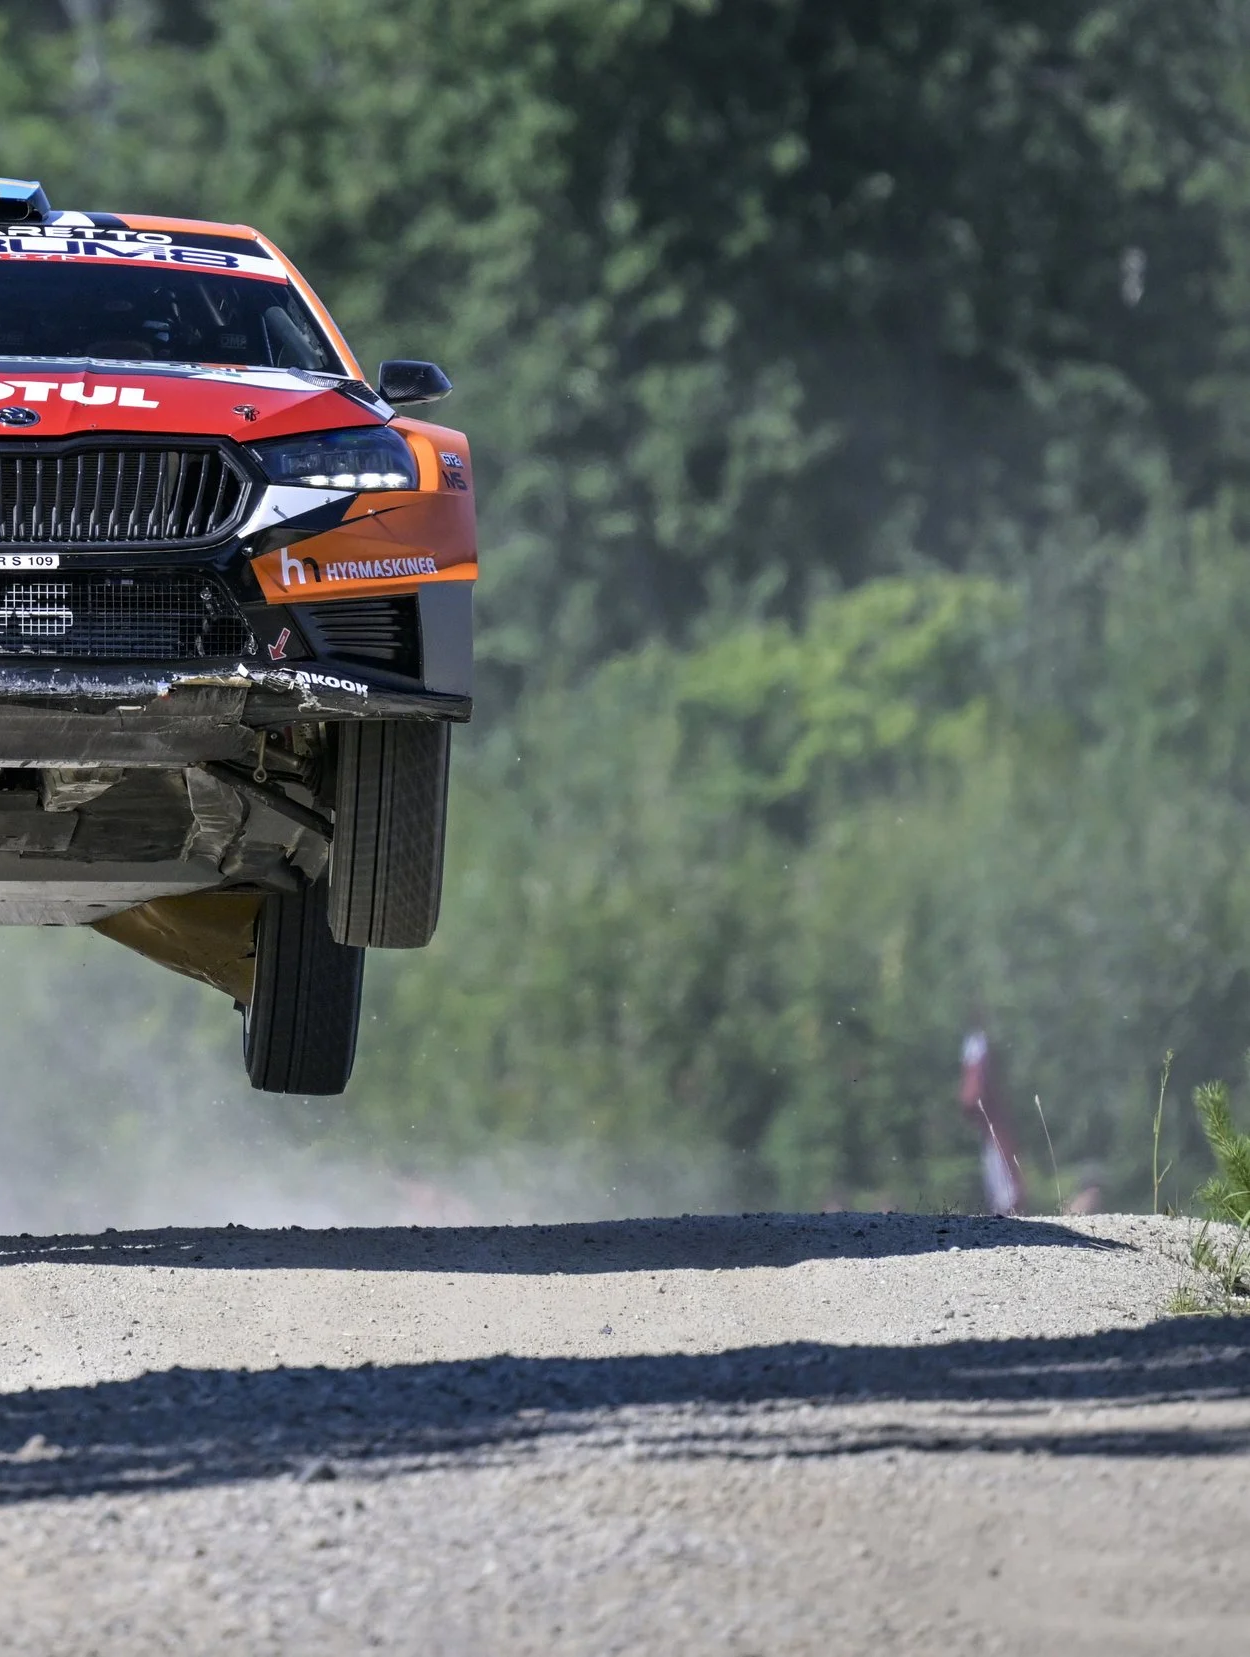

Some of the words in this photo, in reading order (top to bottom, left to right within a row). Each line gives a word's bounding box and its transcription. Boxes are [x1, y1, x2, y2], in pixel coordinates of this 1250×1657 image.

[12, 556, 22, 566] S
[28, 556, 54, 566] 109
[326, 556, 439, 582] HYRMASKINER
